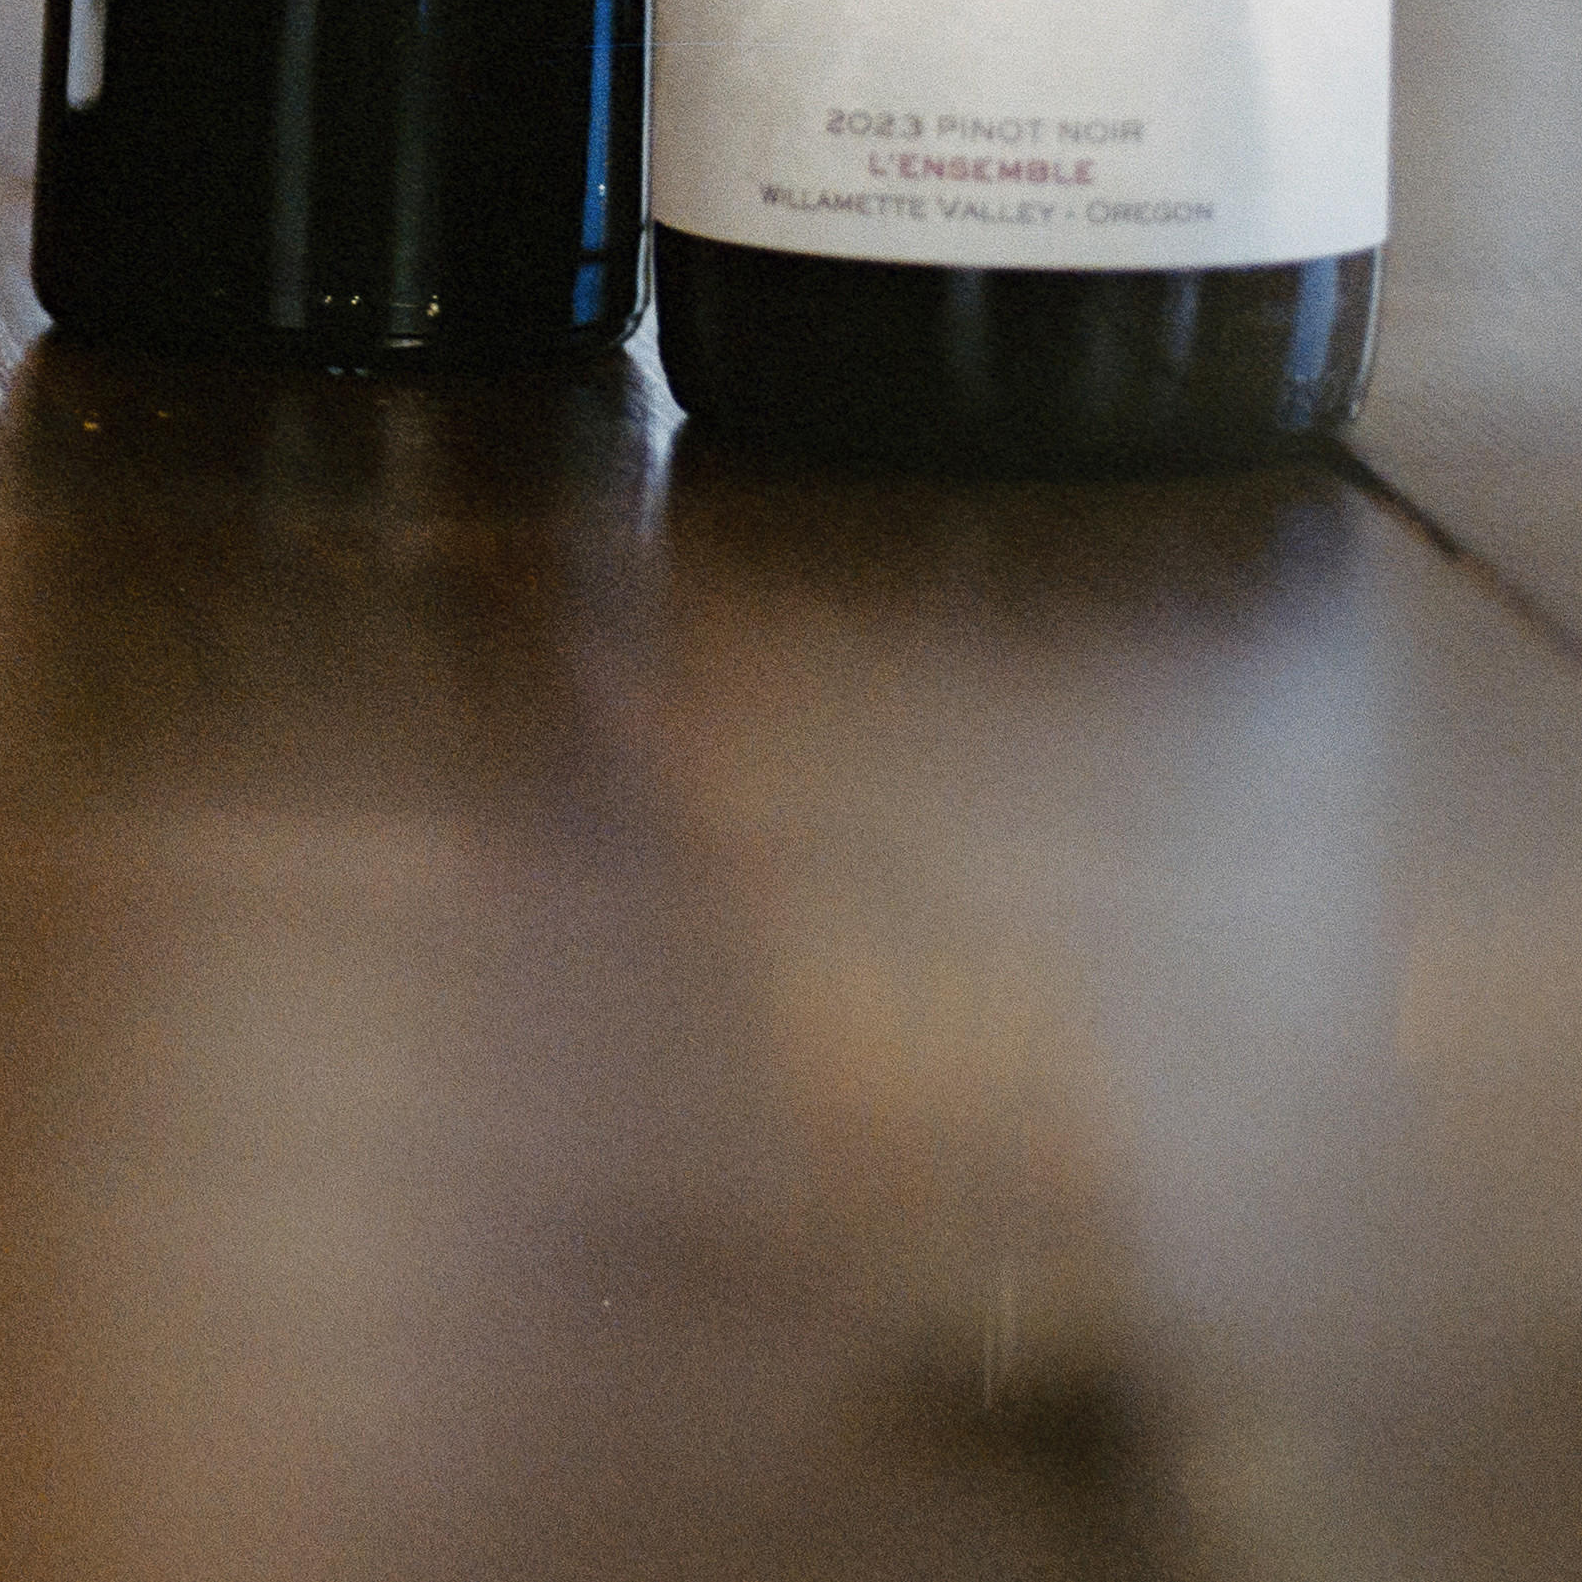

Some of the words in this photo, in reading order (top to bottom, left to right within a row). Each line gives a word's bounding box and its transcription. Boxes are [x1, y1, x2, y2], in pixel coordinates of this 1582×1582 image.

[825, 108, 923, 138] 2023
[937, 113, 1041, 142] PINOT
[1057, 117, 1145, 143] NOIR
[868, 151, 1094, 186] L'ENSEMBLE
[760, 182, 927, 222] WILLAMETTE
[937, 198, 1055, 225] VALLEY
[1084, 198, 1214, 226] OREGON
